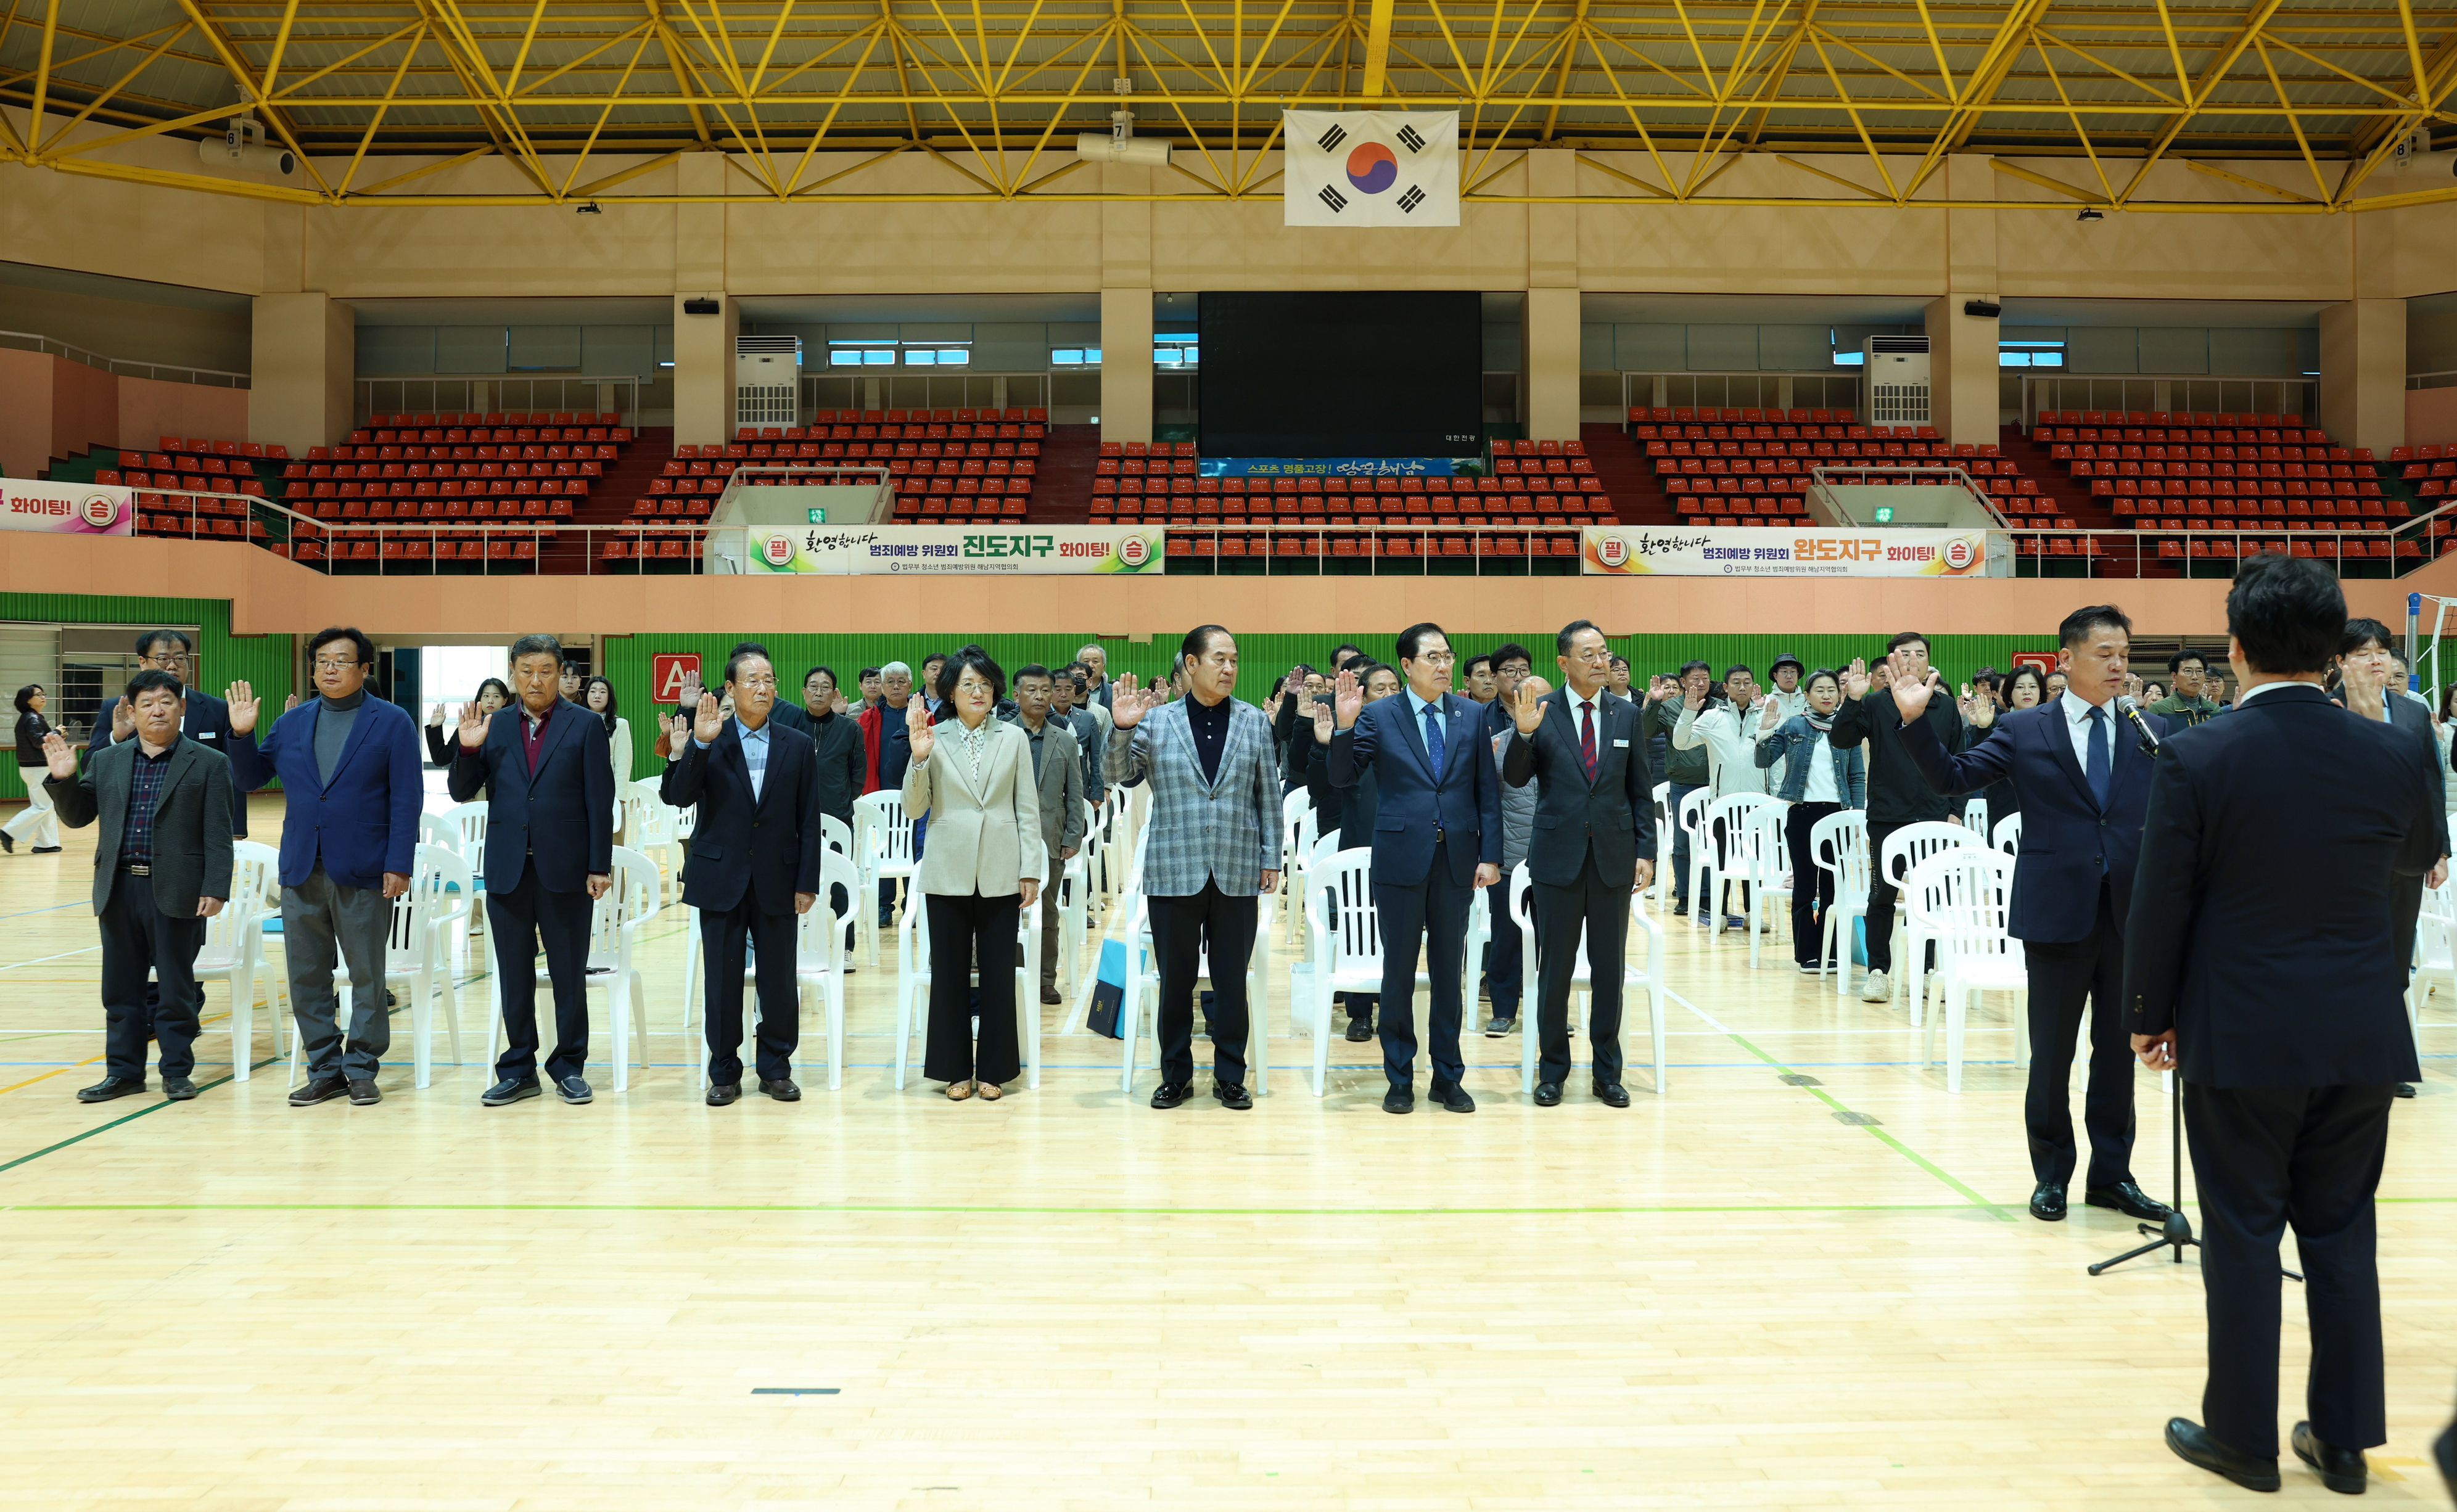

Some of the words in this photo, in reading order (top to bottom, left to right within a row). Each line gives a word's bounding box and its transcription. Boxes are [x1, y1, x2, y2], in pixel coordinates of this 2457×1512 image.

[228, 133, 234, 144] 6
[1115, 125, 1122, 137] 7
[2397, 144, 2405, 155] 8
[1247, 464, 1280, 473] 스포츠
[1283, 464, 1331, 474] 명품고장!
[10, 497, 71, 516] 화이팅!
[90, 500, 109, 518] 승
[770, 540, 786, 557] 필
[805, 530, 878, 553] 환영합니다
[870, 544, 918, 557] 범죄예방
[921, 544, 958, 557] 위원회
[963, 535, 1054, 557] 진도지구
[1060, 542, 1109, 557] 화이팅!
[1126, 541, 1142, 557] 승
[1605, 541, 1621, 558] 필
[1640, 533, 1711, 556] 환영합니다
[1703, 548, 1751, 559] 범죄예방
[1754, 548, 1789, 560] 위원회
[1794, 539, 1882, 561] 완도지구
[1887, 546, 1935, 561] 화이팅!
[1951, 544, 1966, 560] 승
[661, 660, 686, 696] A
